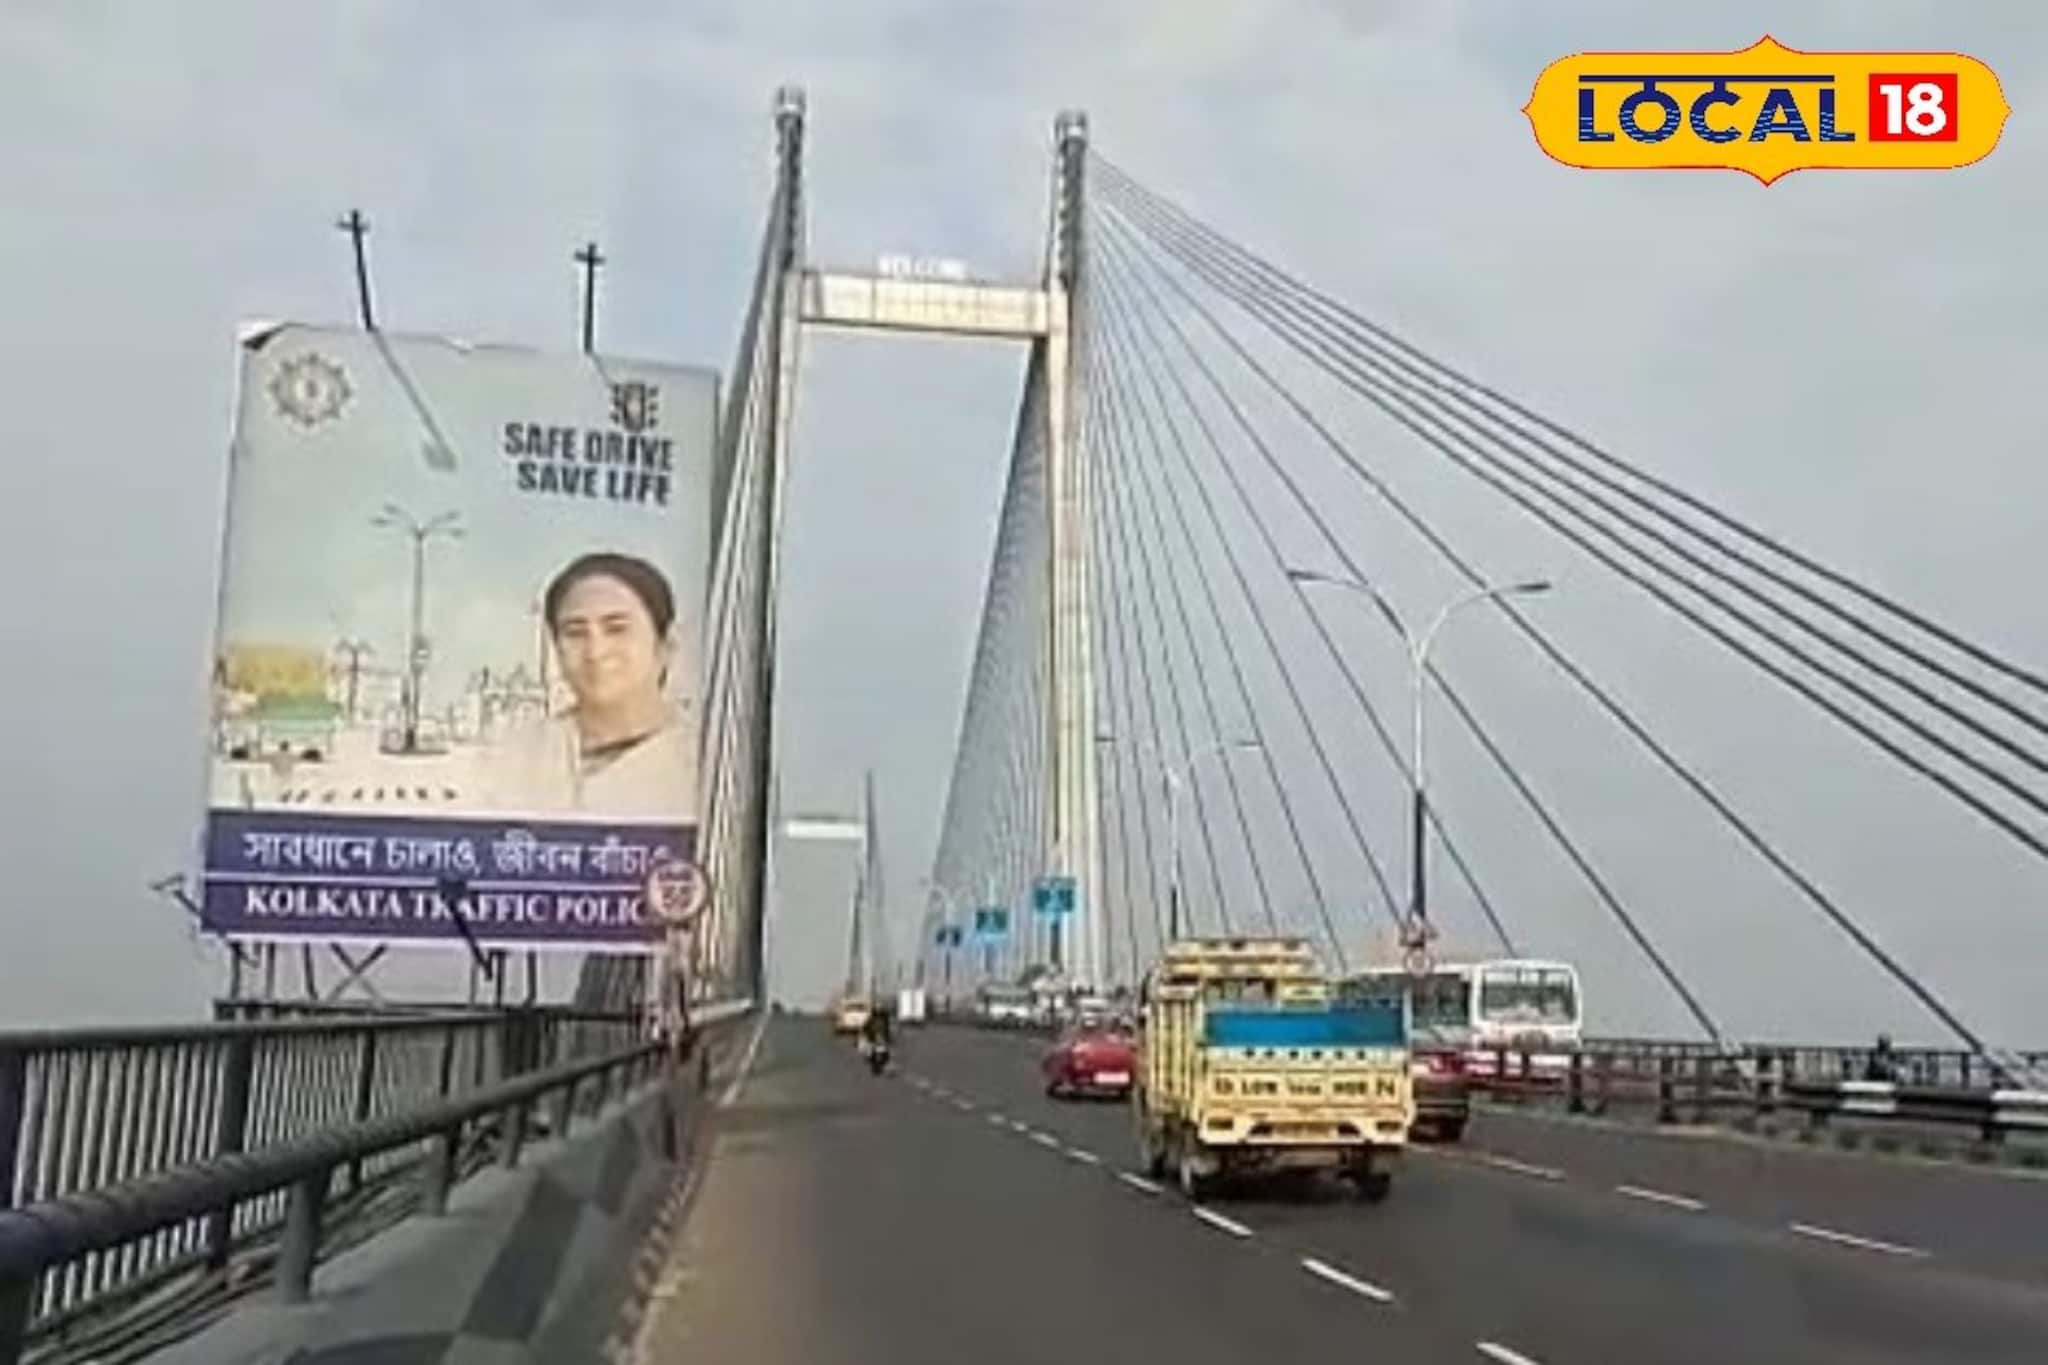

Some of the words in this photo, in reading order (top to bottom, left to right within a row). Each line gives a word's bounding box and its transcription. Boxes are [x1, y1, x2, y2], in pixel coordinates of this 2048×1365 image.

[505, 423, 577, 461] SAFE
[585, 432, 673, 470] DRIVE
[518, 462, 598, 498] SAVE
[608, 470, 670, 506] LIFE
[243, 832, 377, 869] সাবধানে
[386, 837, 481, 876] চালাও,
[493, 829, 582, 874] জীবন
[246, 885, 402, 919] KOLKATA
[555, 894, 649, 926] POLIC
